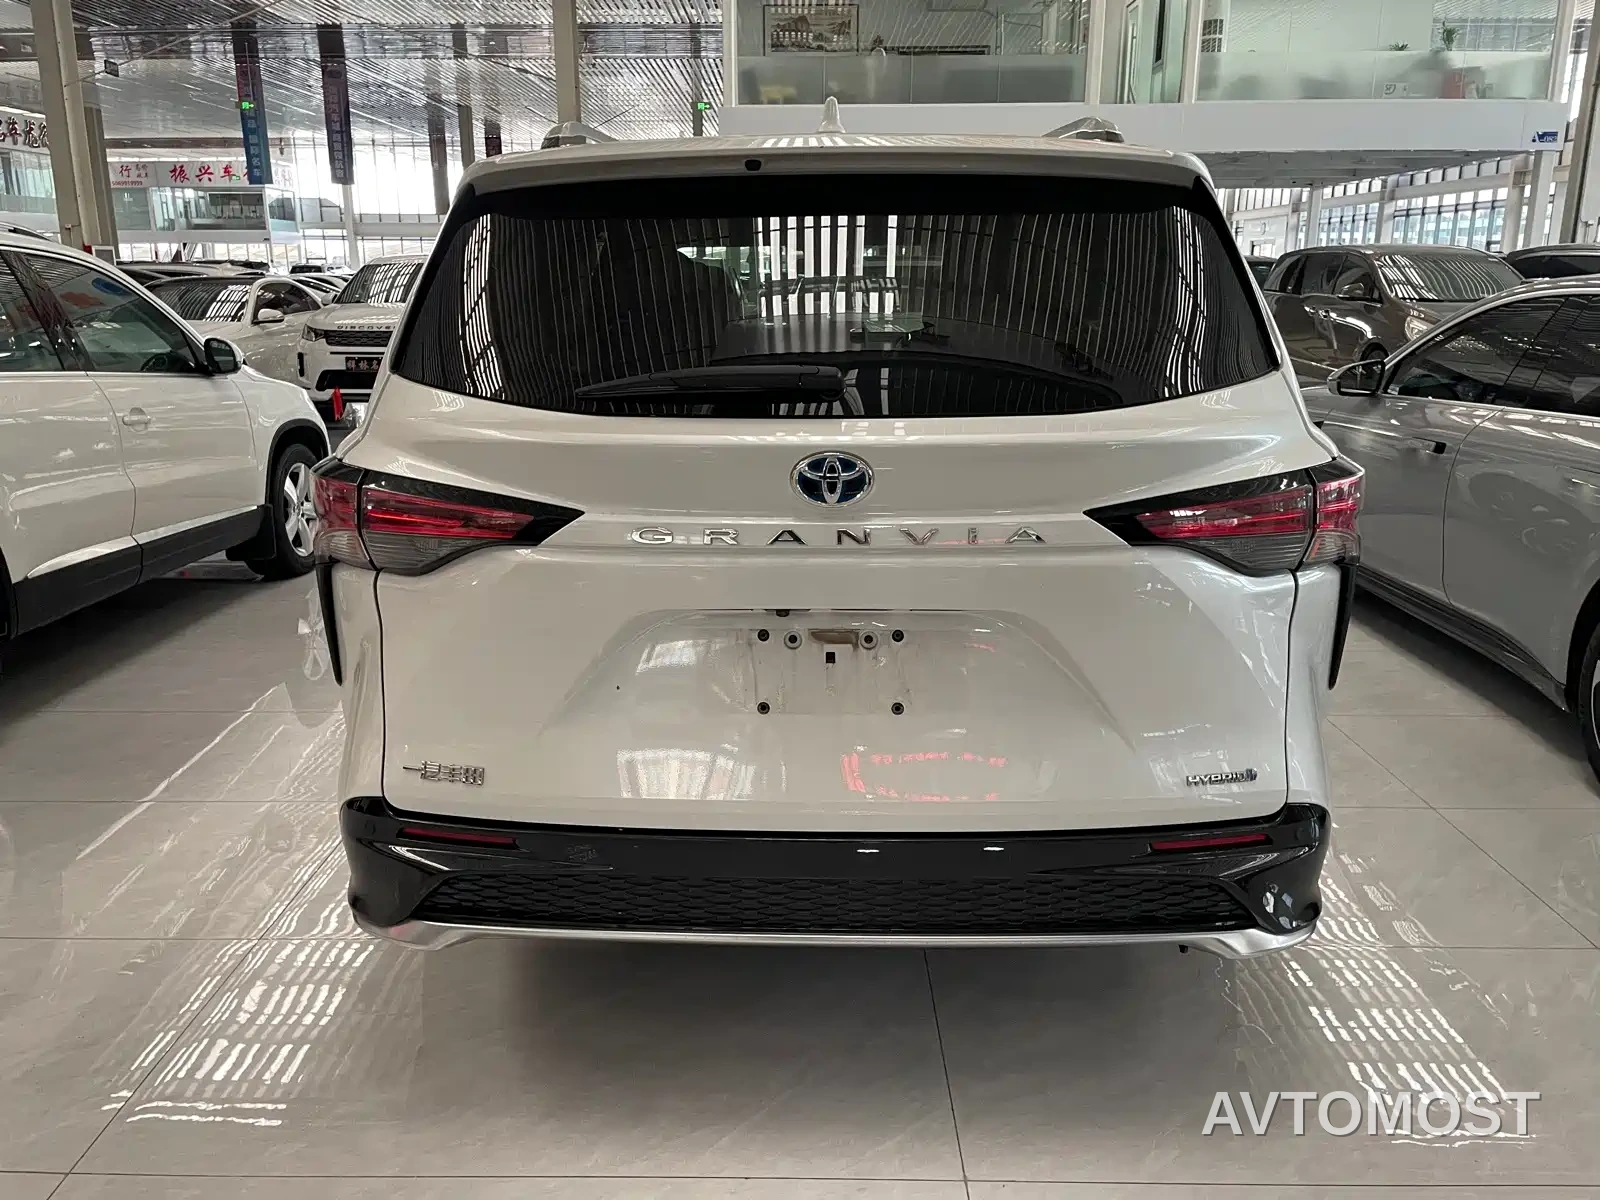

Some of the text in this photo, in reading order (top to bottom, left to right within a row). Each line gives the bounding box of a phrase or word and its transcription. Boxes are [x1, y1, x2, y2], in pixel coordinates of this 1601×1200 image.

[119, 165, 132, 178] 行
[169, 164, 248, 183] 振兴车
[631, 525, 1047, 546] GRANVIA
[1186, 772, 1245, 786] HYBRID
